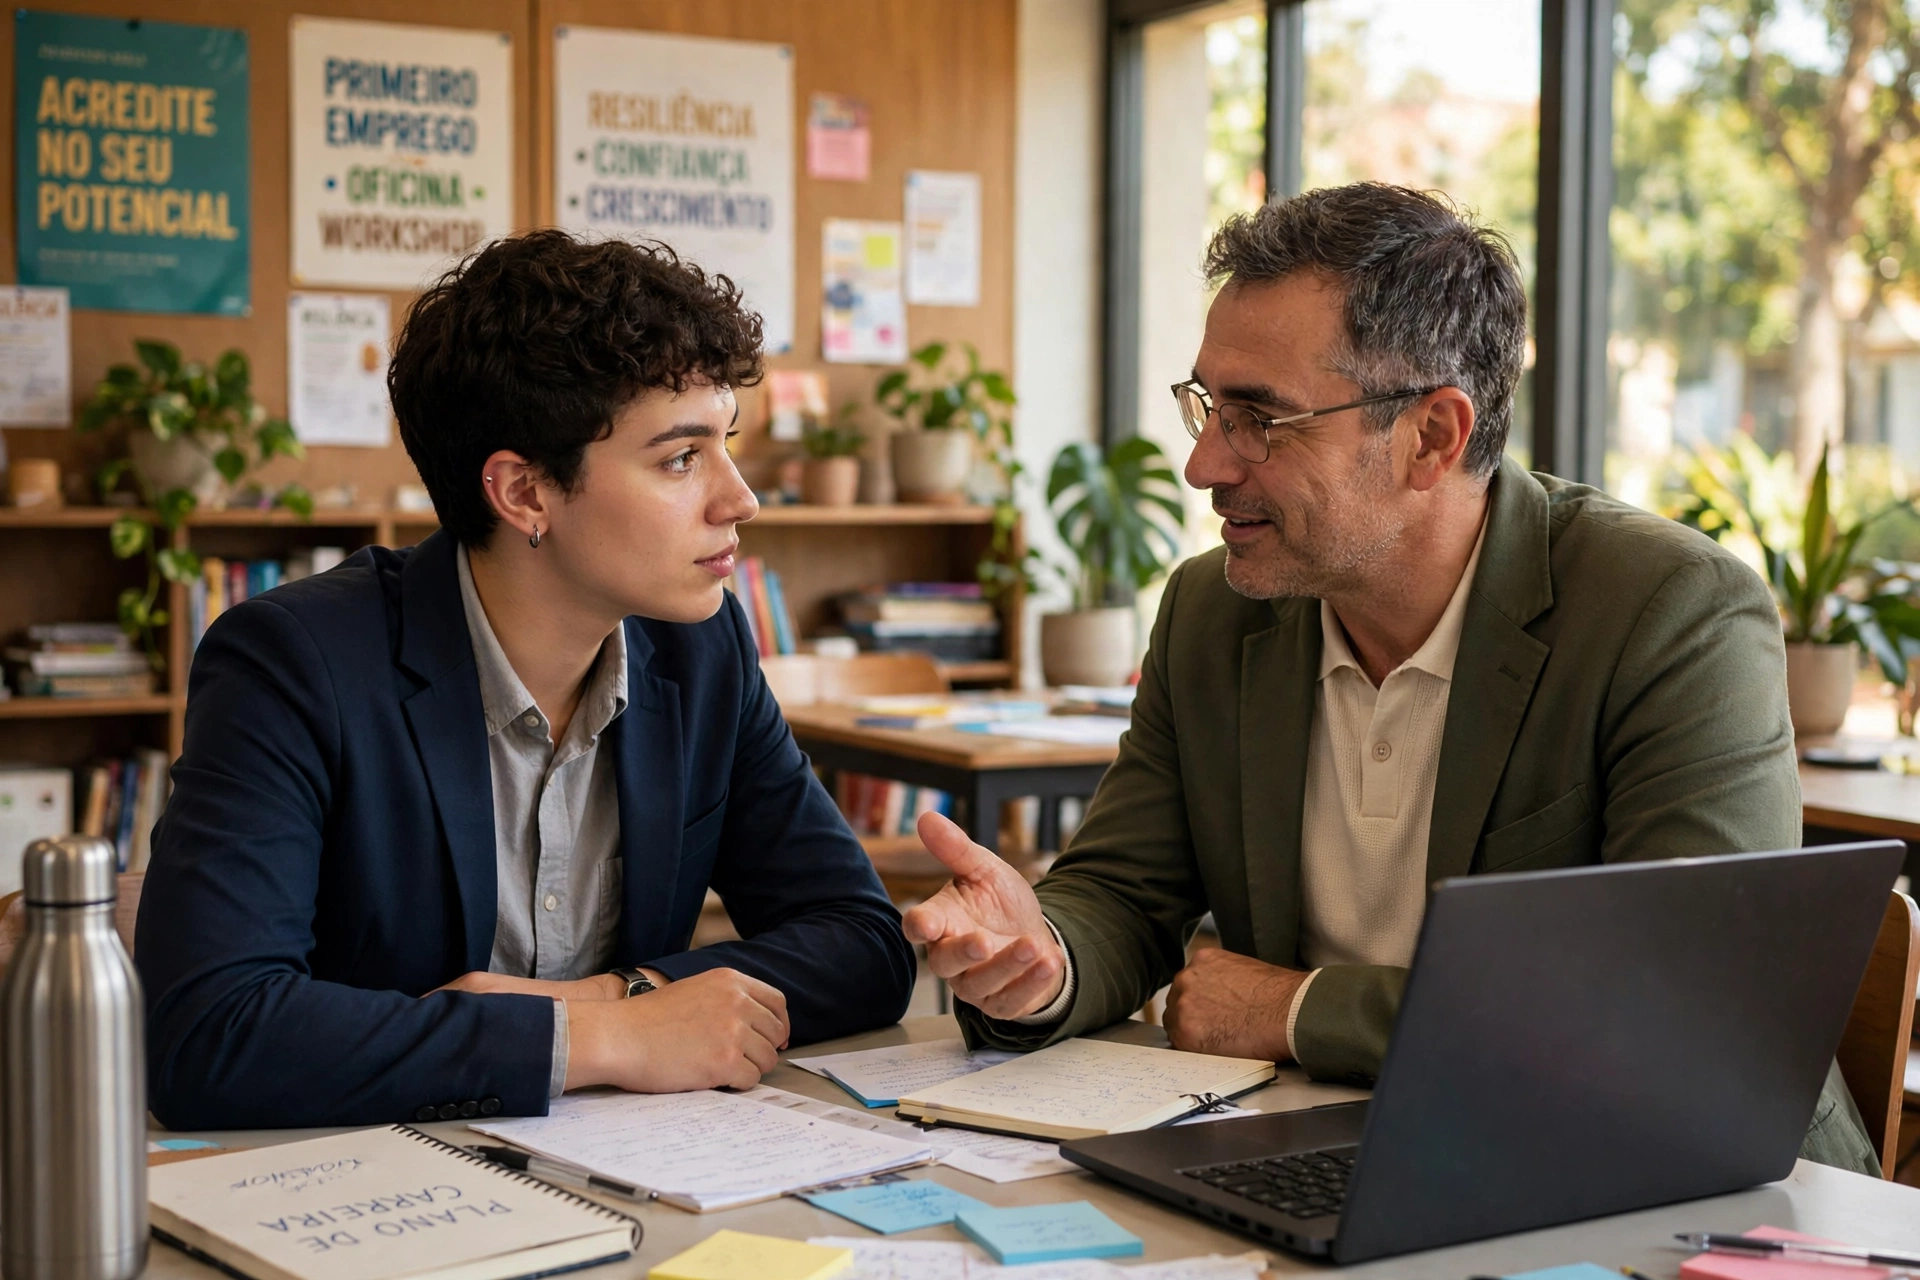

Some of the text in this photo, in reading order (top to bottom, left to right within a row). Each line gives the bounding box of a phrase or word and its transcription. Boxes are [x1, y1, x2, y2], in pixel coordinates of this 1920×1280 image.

[37, 76, 216, 136] ACREDITE
[325, 58, 478, 107] PRIMEIRO
[325, 107, 477, 154] EMPREGO
[589, 91, 756, 138] RESILIÊNCIA
[37, 130, 173, 183] NO SEU
[595, 139, 747, 185] CONFIANÇA
[347, 165, 466, 209] OFICINA
[586, 187, 772, 232] CRESCIMENTO
[37, 183, 238, 241] POTENCIAL
[318, 210, 486, 255] WORKSHOP
[258, 1185, 462, 1232] CARREIRA
[298, 1199, 512, 1254] PLANO DE
